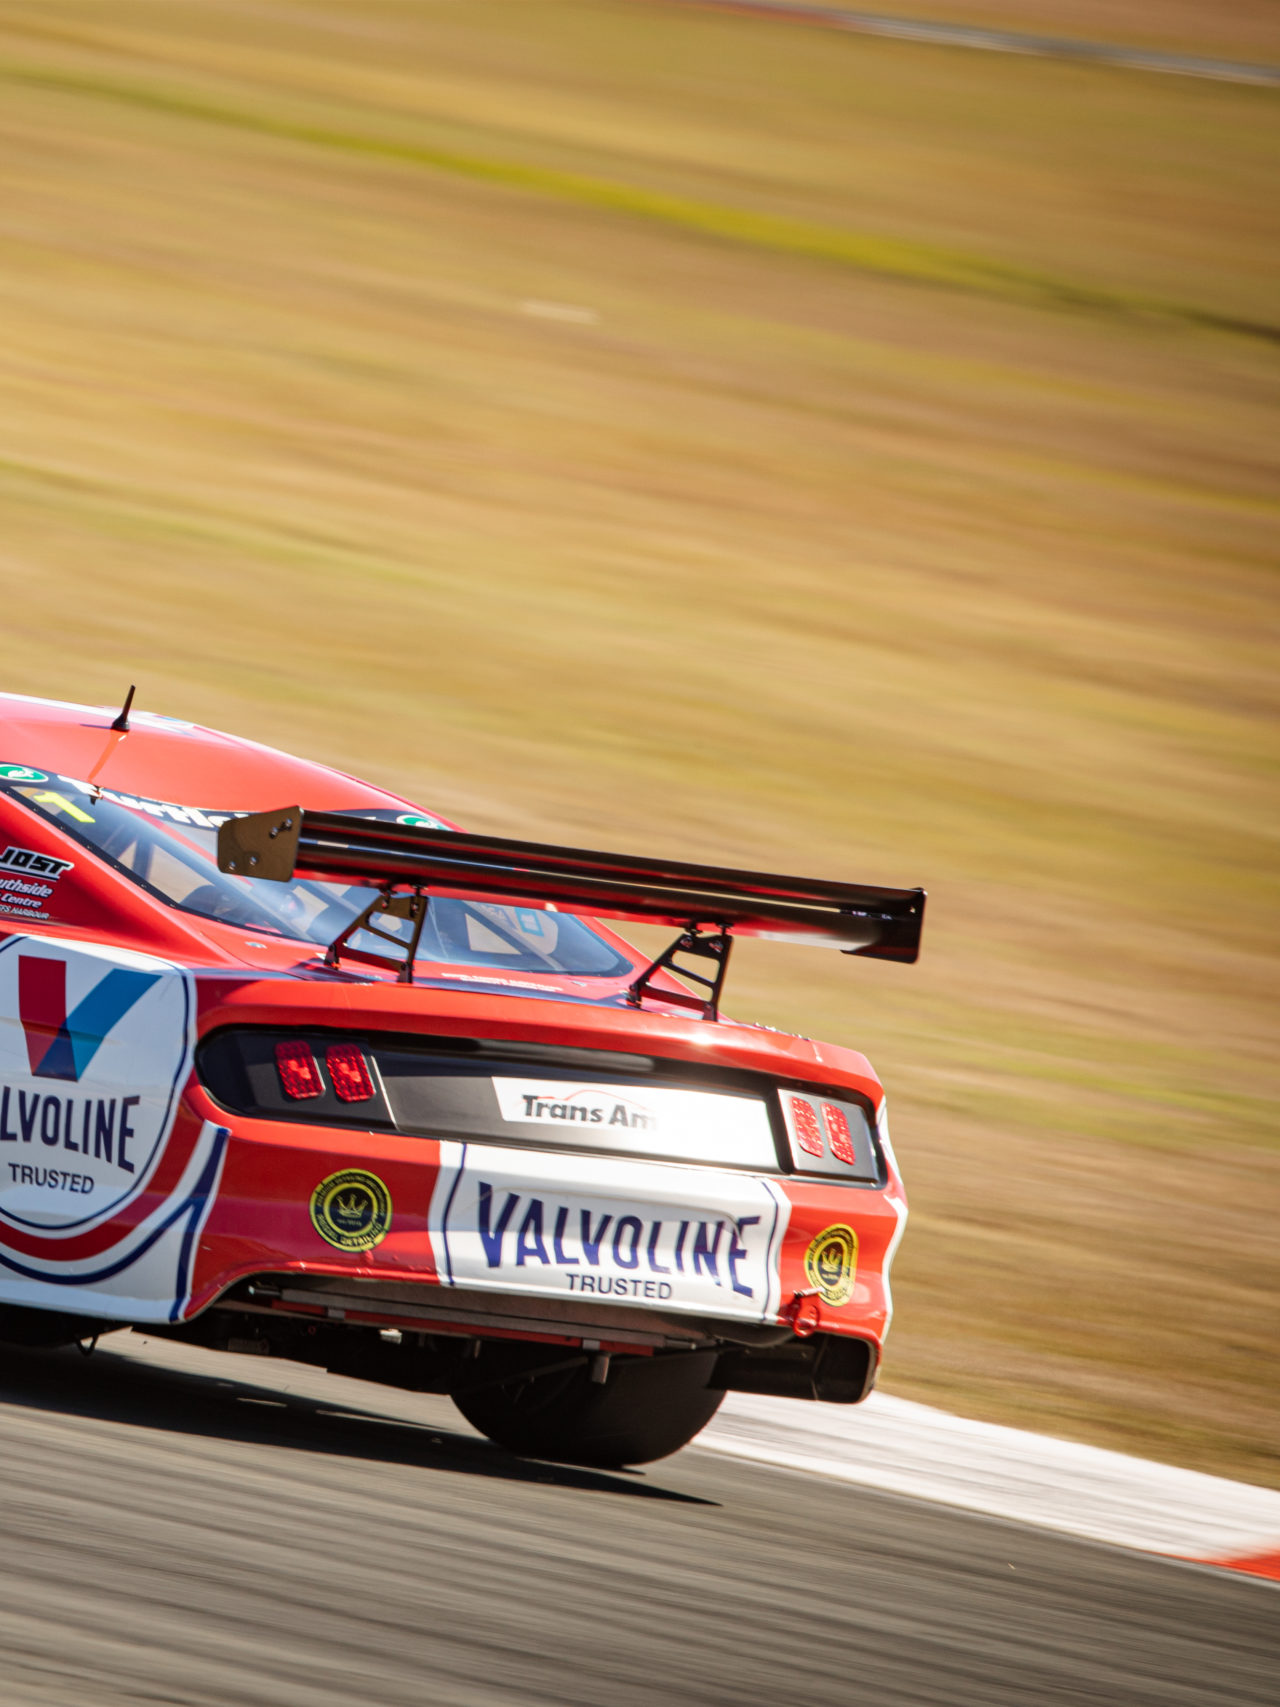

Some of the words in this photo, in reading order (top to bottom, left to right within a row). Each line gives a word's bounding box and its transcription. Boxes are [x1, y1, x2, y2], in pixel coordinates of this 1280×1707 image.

[1, 893, 42, 908] Centre
[11, 907, 50, 920] HARBOUR
[522, 1094, 604, 1123] Trans
[8, 1162, 95, 1194] TRUSTED
[478, 1181, 761, 1299] VALVOLINE
[566, 1273, 673, 1300] TRUSTED
